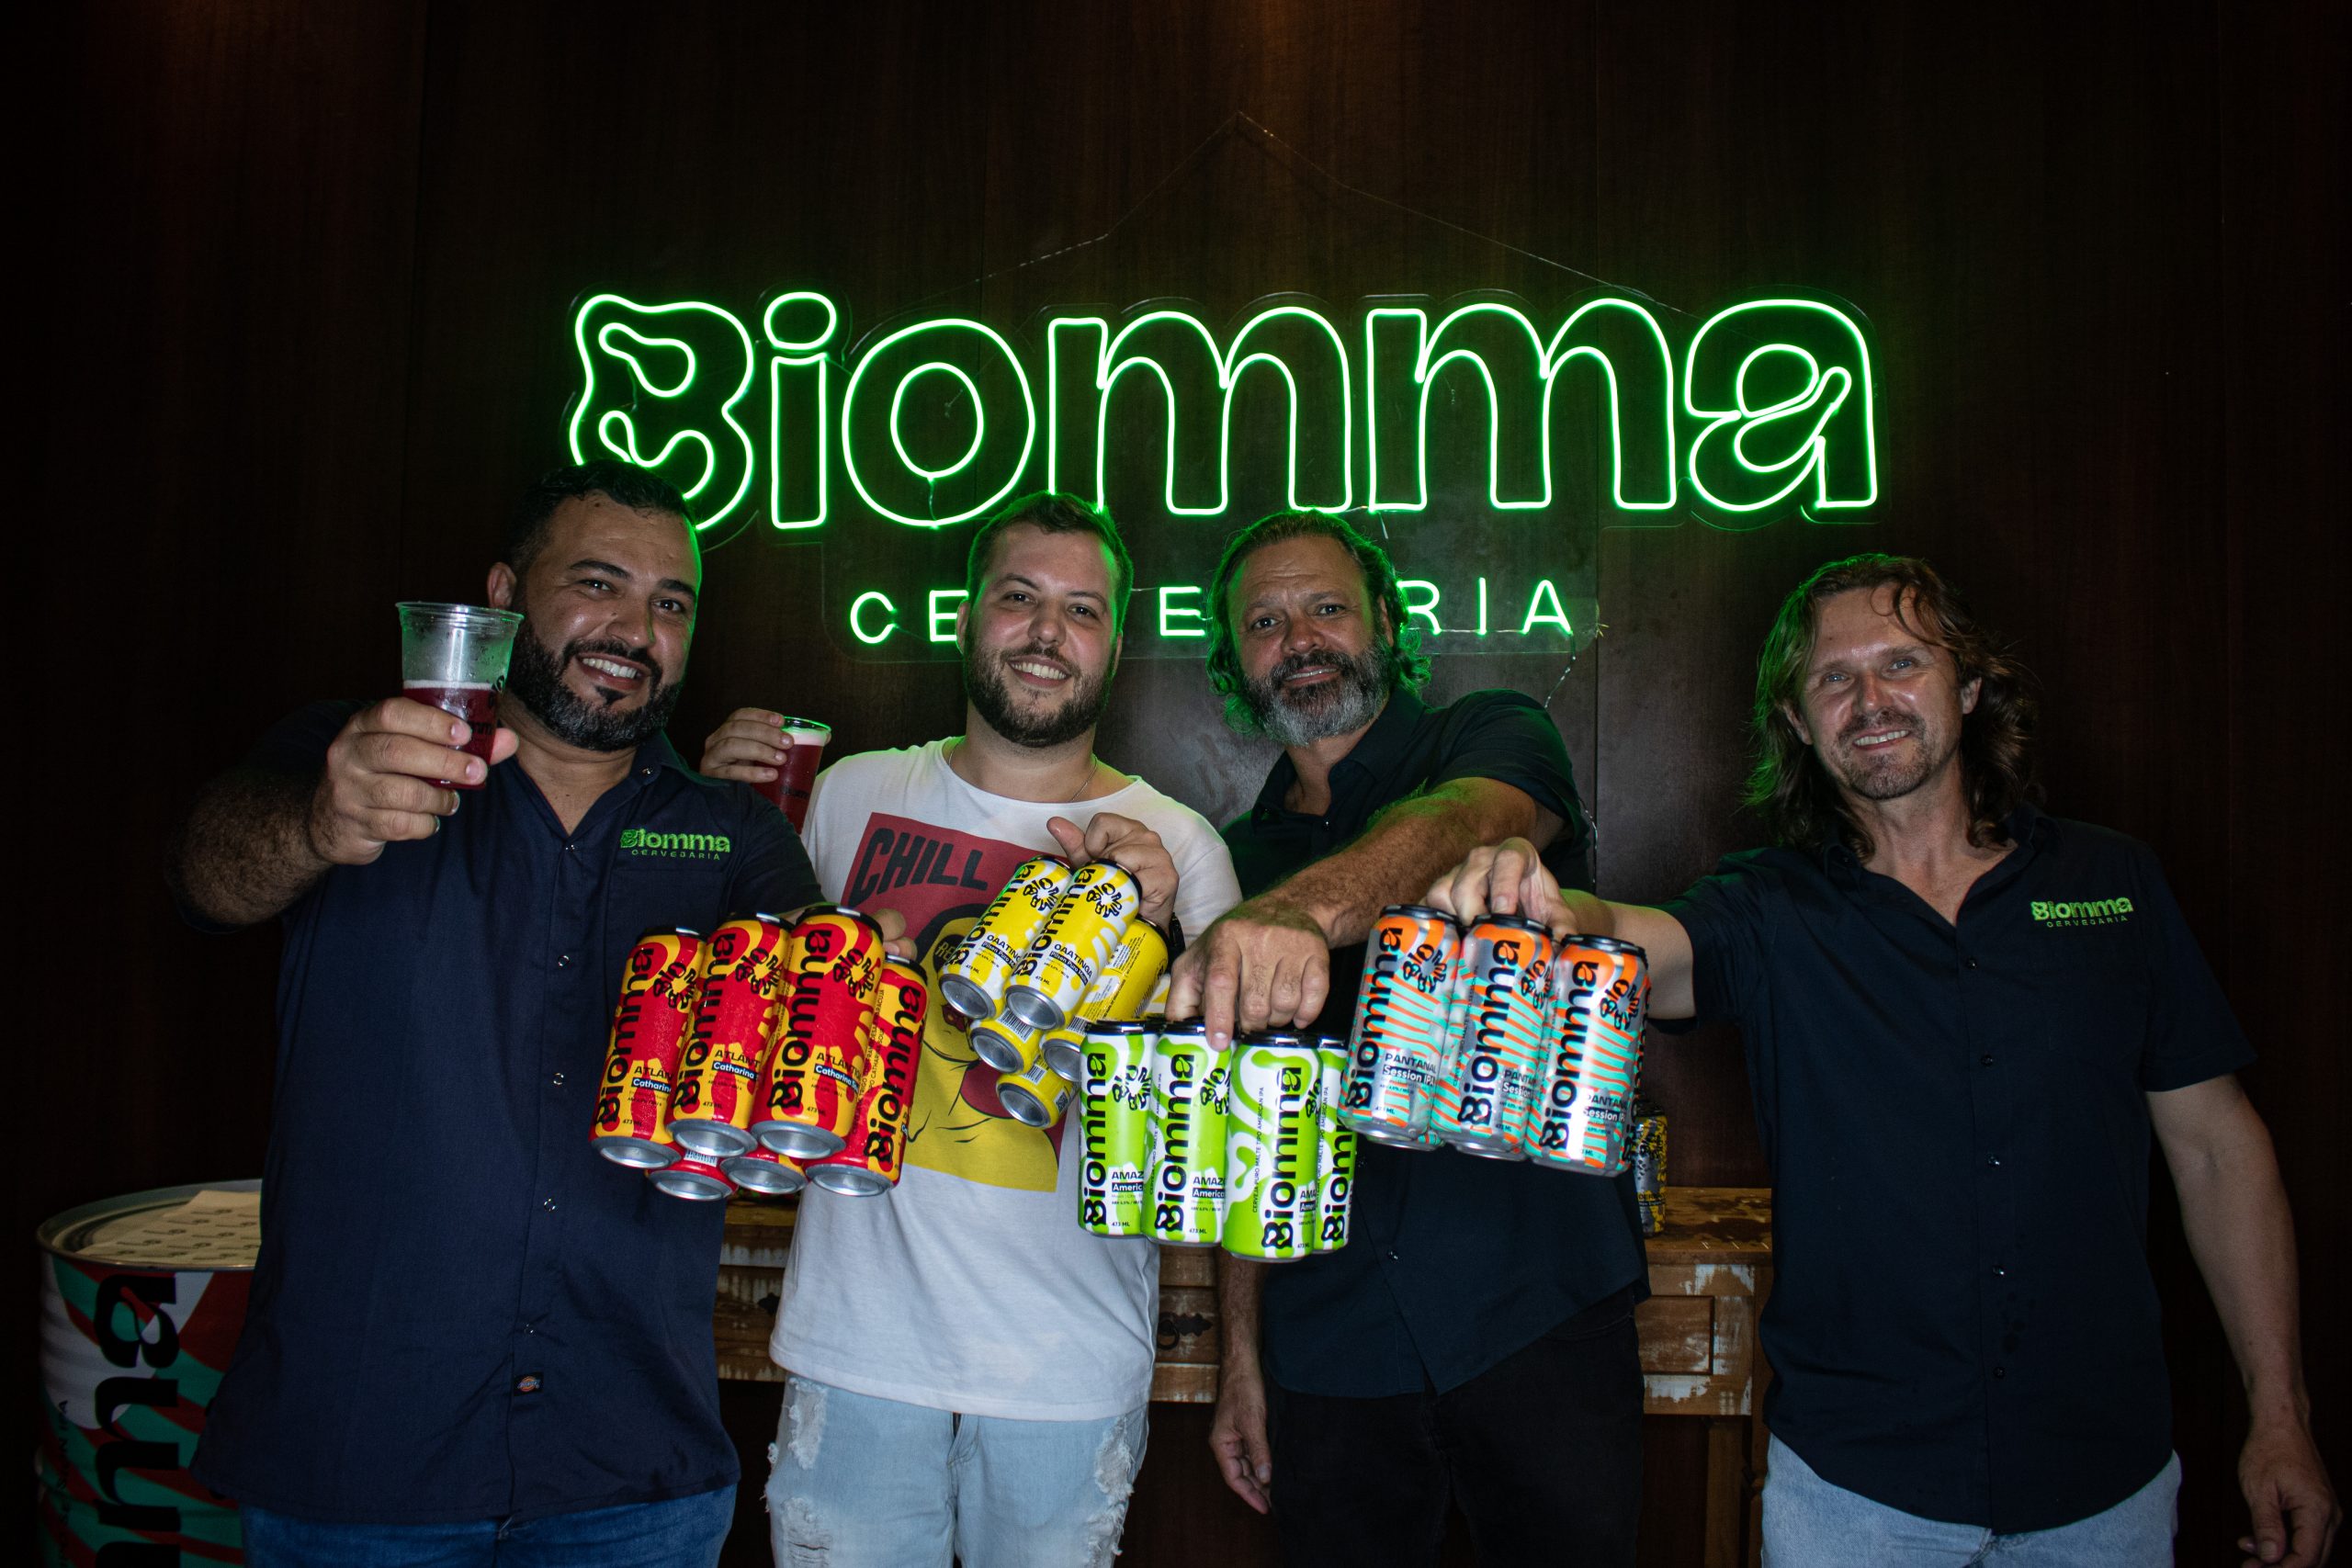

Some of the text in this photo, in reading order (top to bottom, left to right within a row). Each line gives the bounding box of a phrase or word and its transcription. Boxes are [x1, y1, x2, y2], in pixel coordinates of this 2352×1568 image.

[570, 289, 1880, 532] Biomma
[620, 828, 731, 853] Biomma
[630, 848, 721, 861] CERVEJARIA
[849, 828, 987, 908] CHILL
[2030, 897, 2134, 920] Biomma
[2046, 914, 2129, 928] CERVEJARIA
[595, 948, 654, 1126] Biomma
[633, 1078, 672, 1093] Catharin
[671, 931, 736, 1110] Biomma
[713, 1062, 754, 1079] Catharina
[765, 930, 832, 1110] Biomma
[815, 1065, 852, 1087] Catharina
[864, 985, 921, 1164] Biomma
[1345, 927, 1403, 1110] Biomma
[1384, 1066, 1422, 1082] Session
[1458, 940, 1521, 1124] Biomma
[1539, 962, 1600, 1150] Biomma
[1083, 1053, 1106, 1224] Biomma
[1154, 1054, 1194, 1232] Biomma
[1261, 1067, 1302, 1248] Biomma
